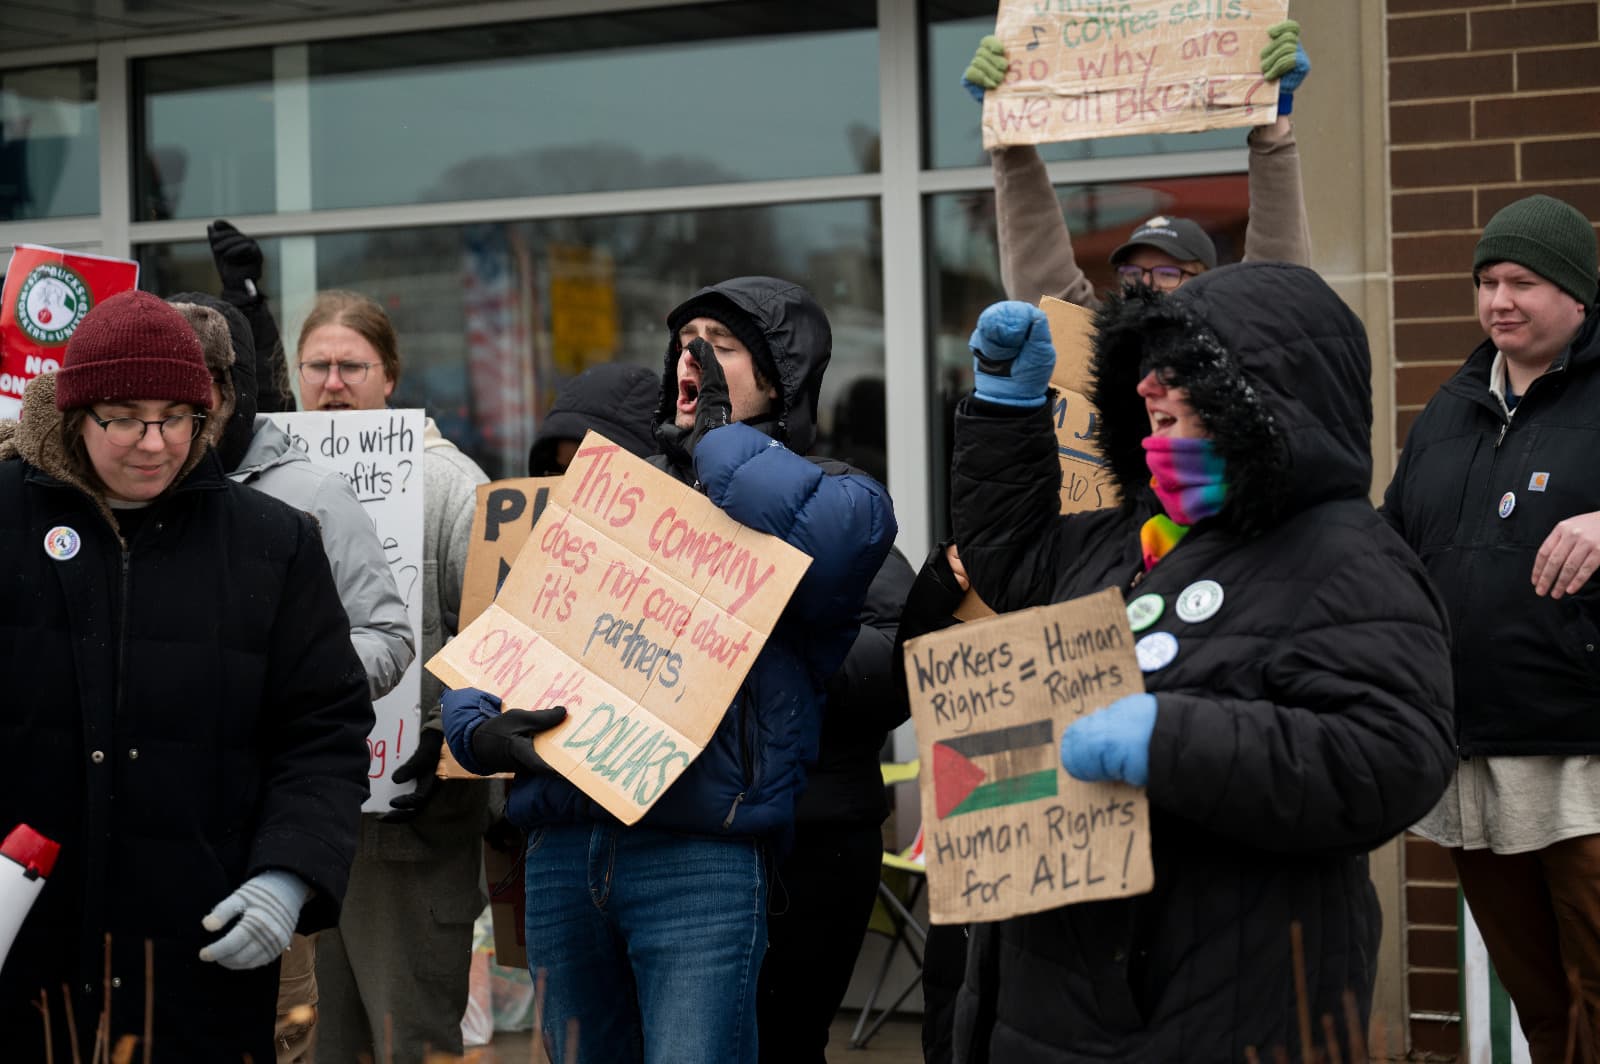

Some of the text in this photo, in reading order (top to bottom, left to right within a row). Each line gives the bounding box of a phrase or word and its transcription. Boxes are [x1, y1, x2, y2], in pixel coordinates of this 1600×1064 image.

[1063, 4, 1159, 48] coffee
[1006, 30, 1240, 98] so why are
[1061, 88, 1102, 125] all
[25, 355, 60, 376] NO
[320, 418, 350, 458] do
[359, 416, 414, 455] with
[571, 444, 646, 528] This
[532, 571, 578, 623] it's
[540, 508, 750, 670] does not care about
[1043, 621, 1123, 667] Human
[930, 663, 1123, 733] Rights Rights
[563, 702, 690, 806] DOLLARS
[934, 799, 1136, 865] Human Rights
[961, 868, 1012, 908] for
